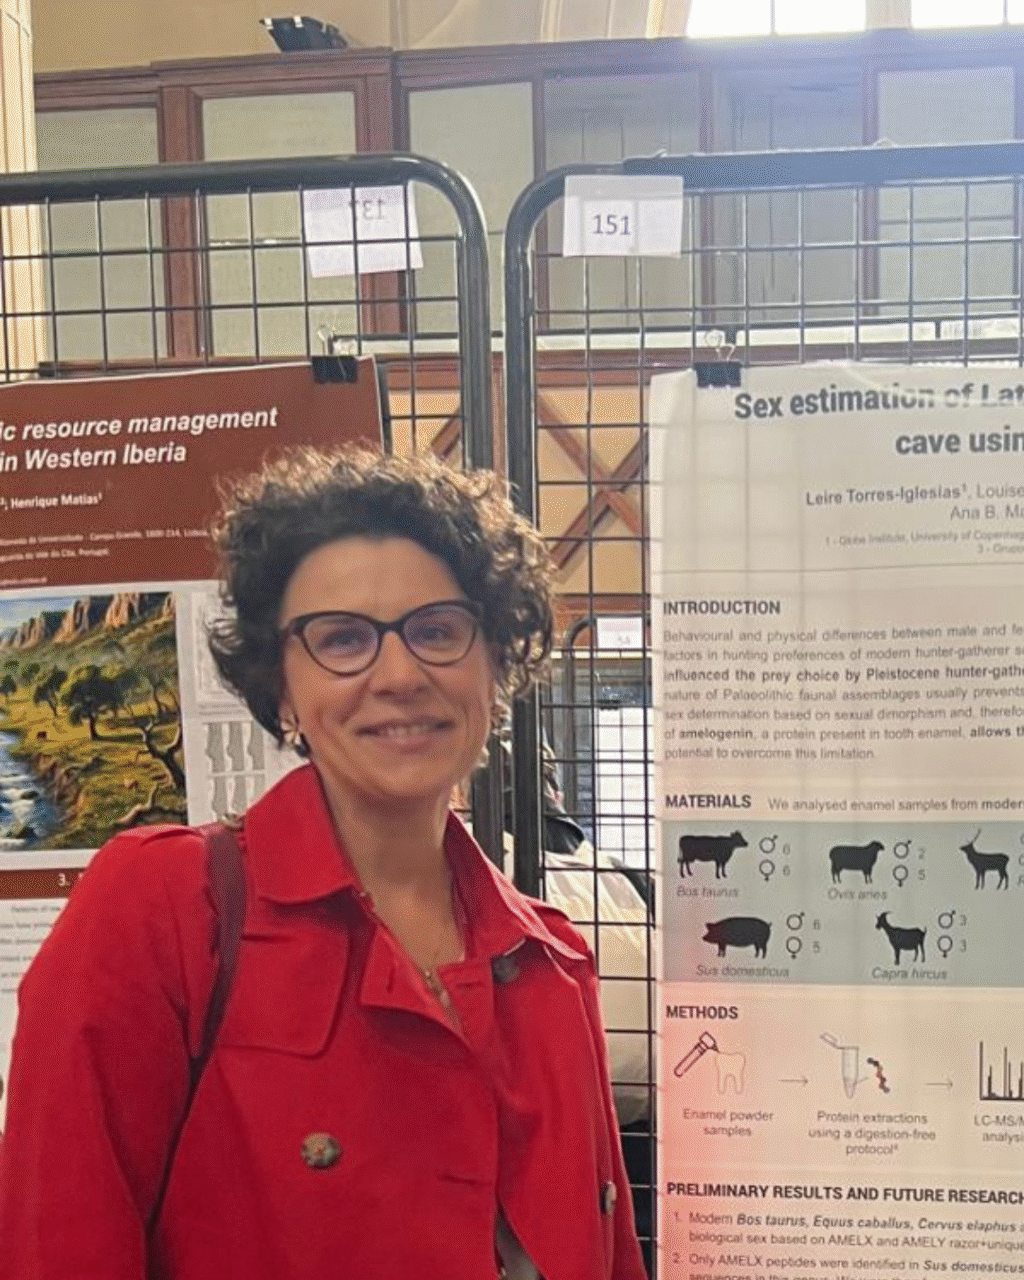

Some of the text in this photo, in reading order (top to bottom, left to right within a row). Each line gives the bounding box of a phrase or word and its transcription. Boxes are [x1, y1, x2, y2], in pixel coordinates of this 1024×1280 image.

[592, 213, 631, 236] 151
[734, 390, 782, 419] Sex
[788, 378, 934, 416] estimation
[22, 418, 122, 440] resource
[127, 406, 279, 435] management
[894, 433, 961, 455] cave
[0, 441, 187, 471] in Western Iberia
[11, 495, 58, 509] Henrique
[804, 490, 843, 506] Leire
[948, 504, 980, 520] Ana
[662, 599, 781, 615] INTRODUCTION
[663, 668, 730, 681] influenced
[734, 668, 756, 681] the
[760, 670, 791, 684] prey
[795, 668, 840, 681] choice
[844, 668, 861, 683] by
[865, 666, 940, 680] Pleistocene
[664, 793, 752, 809] MATERIALS
[791, 799, 848, 812] analysed
[849, 800, 895, 811] enamel
[897, 799, 948, 812] samples
[950, 798, 978, 810] from
[664, 1004, 739, 1020] METHODS
[681, 1107, 774, 1122] Enamel powder
[815, 1109, 928, 1124] Protein extractions
[665, 1181, 769, 1198] PRELIMINARY
[772, 1184, 843, 1200] RESULTS
[845, 1186, 879, 1200] AND
[882, 1186, 944, 1202] FUTURE
[735, 1212, 762, 1225] Bos
[812, 1214, 854, 1229] Equus
[916, 1216, 963, 1230] Cervus
[965, 1219, 1016, 1233] elaphus
